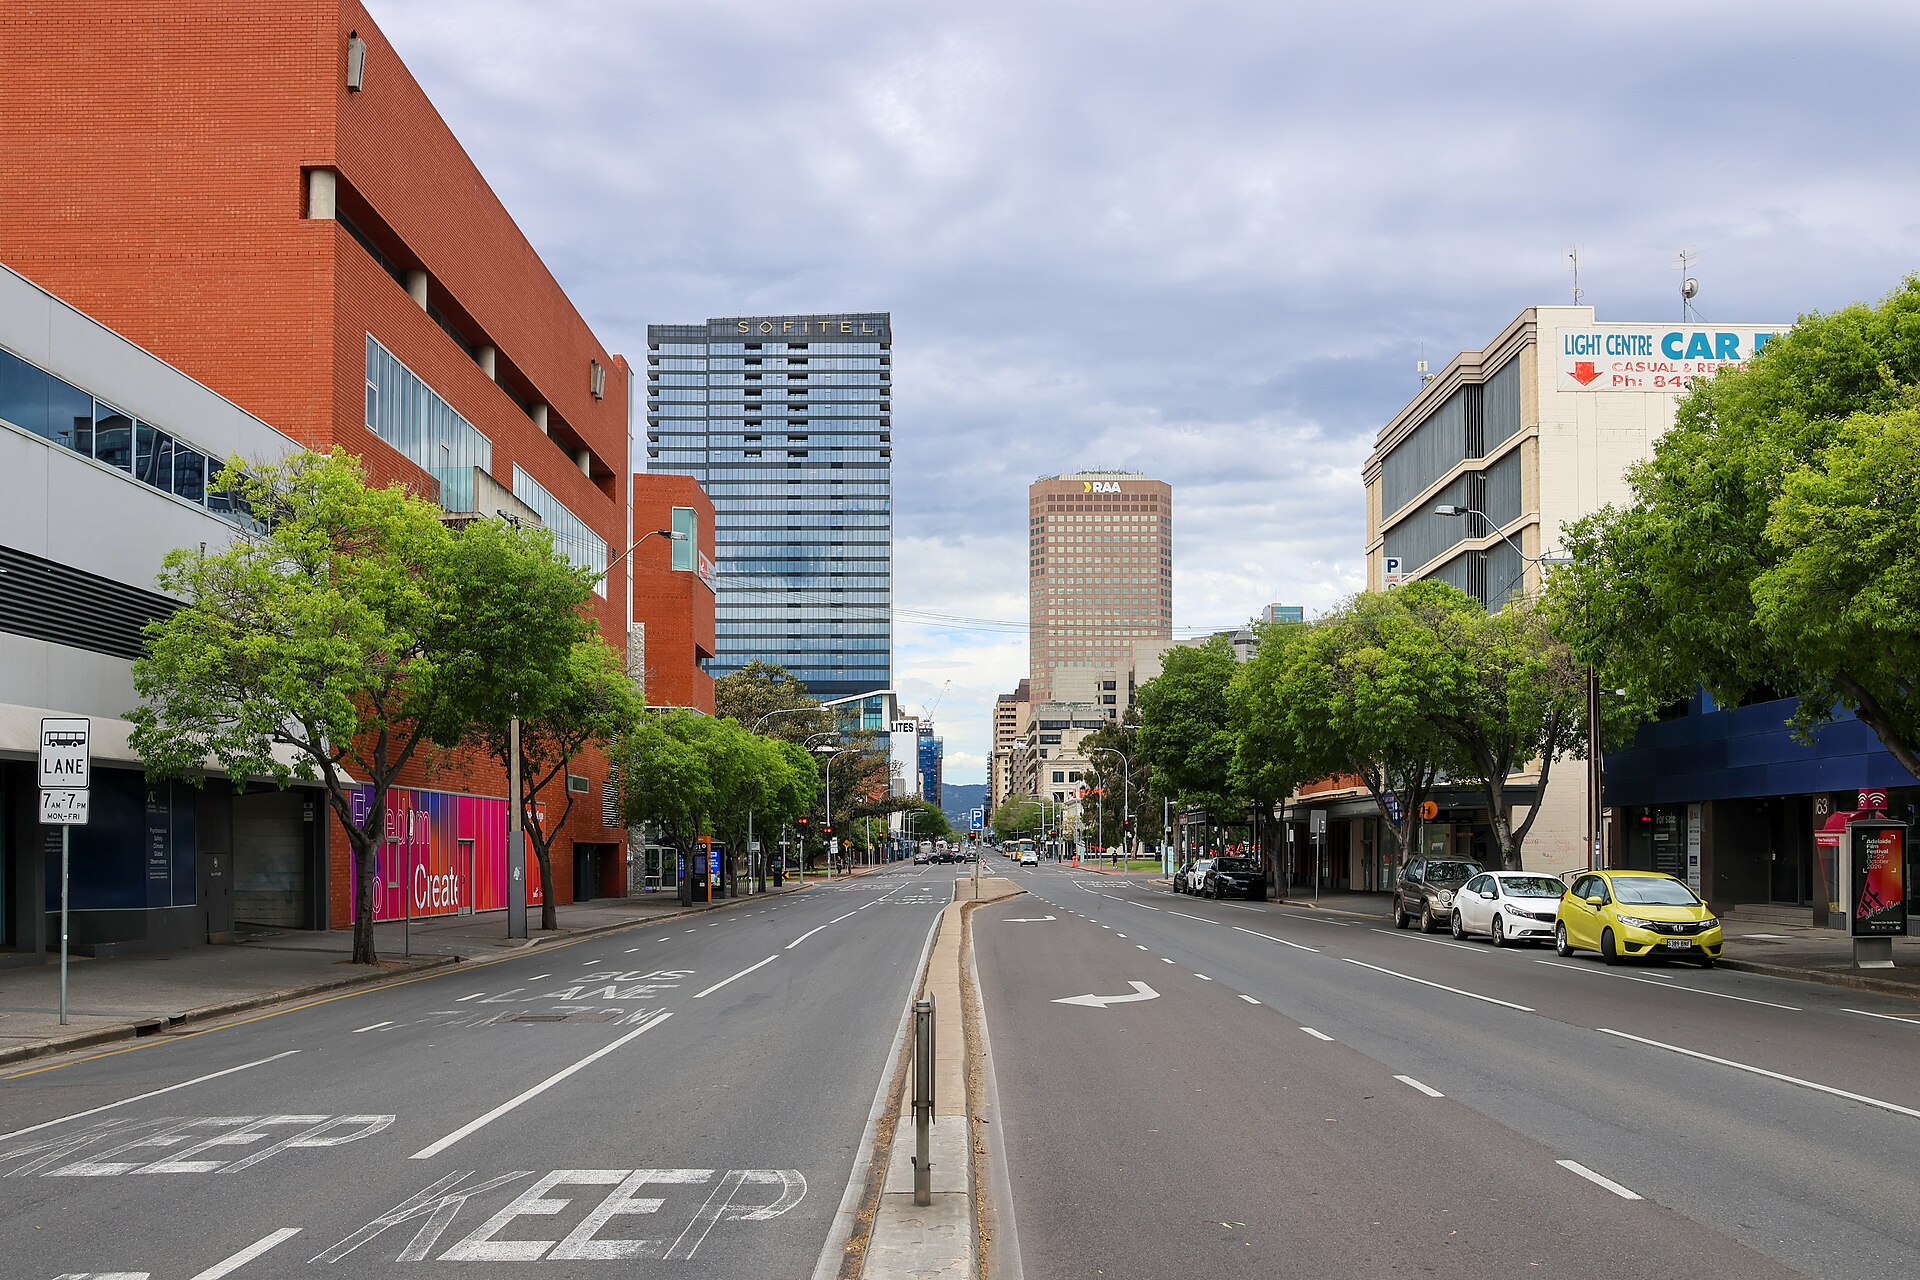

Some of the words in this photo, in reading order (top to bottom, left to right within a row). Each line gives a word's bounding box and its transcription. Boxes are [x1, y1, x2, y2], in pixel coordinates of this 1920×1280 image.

[737, 321, 874, 333] SOFITEL
[1564, 334, 1602, 356] LIGHT
[1606, 334, 1653, 356] CENTRE
[1661, 331, 1742, 360] CAR
[1611, 361, 1679, 373] CASUAL
[1683, 362, 1692, 373] &
[1612, 374, 1643, 387] Ph:
[1093, 481, 1122, 493] RAA
[1387, 559, 1399, 573] P
[44, 758, 84, 774] LANE
[1815, 798, 1828, 815] 163
[973, 811, 982, 822] P
[1656, 813, 1665, 824] For
[568, 969, 696, 983] BUS
[476, 984, 680, 1004] LANE
[307, 1169, 807, 1264] KEEP
